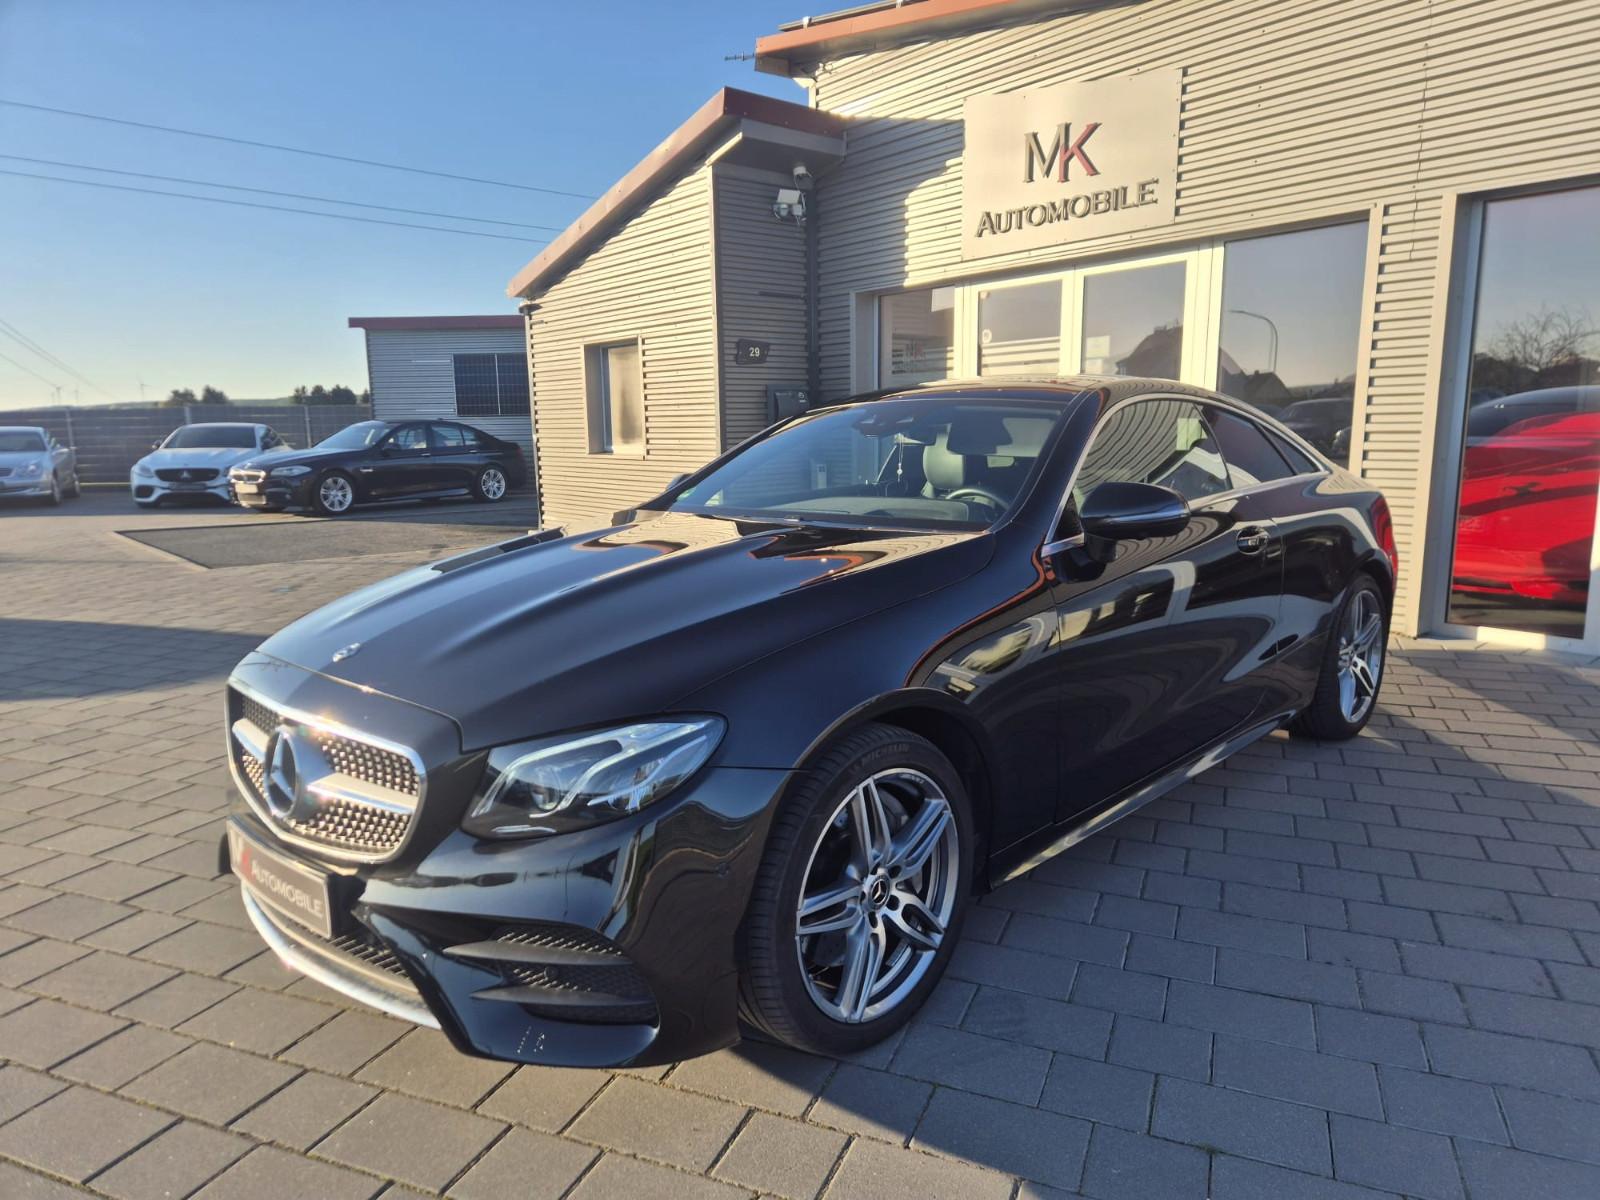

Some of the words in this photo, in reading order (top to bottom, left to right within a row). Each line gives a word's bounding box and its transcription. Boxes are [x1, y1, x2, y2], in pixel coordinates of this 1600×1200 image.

[1023, 122, 1102, 183] MK
[975, 178, 1159, 237] AUTOMOBILE
[749, 347, 760, 357] 29
[251, 860, 323, 919] AUTOMOBILE
